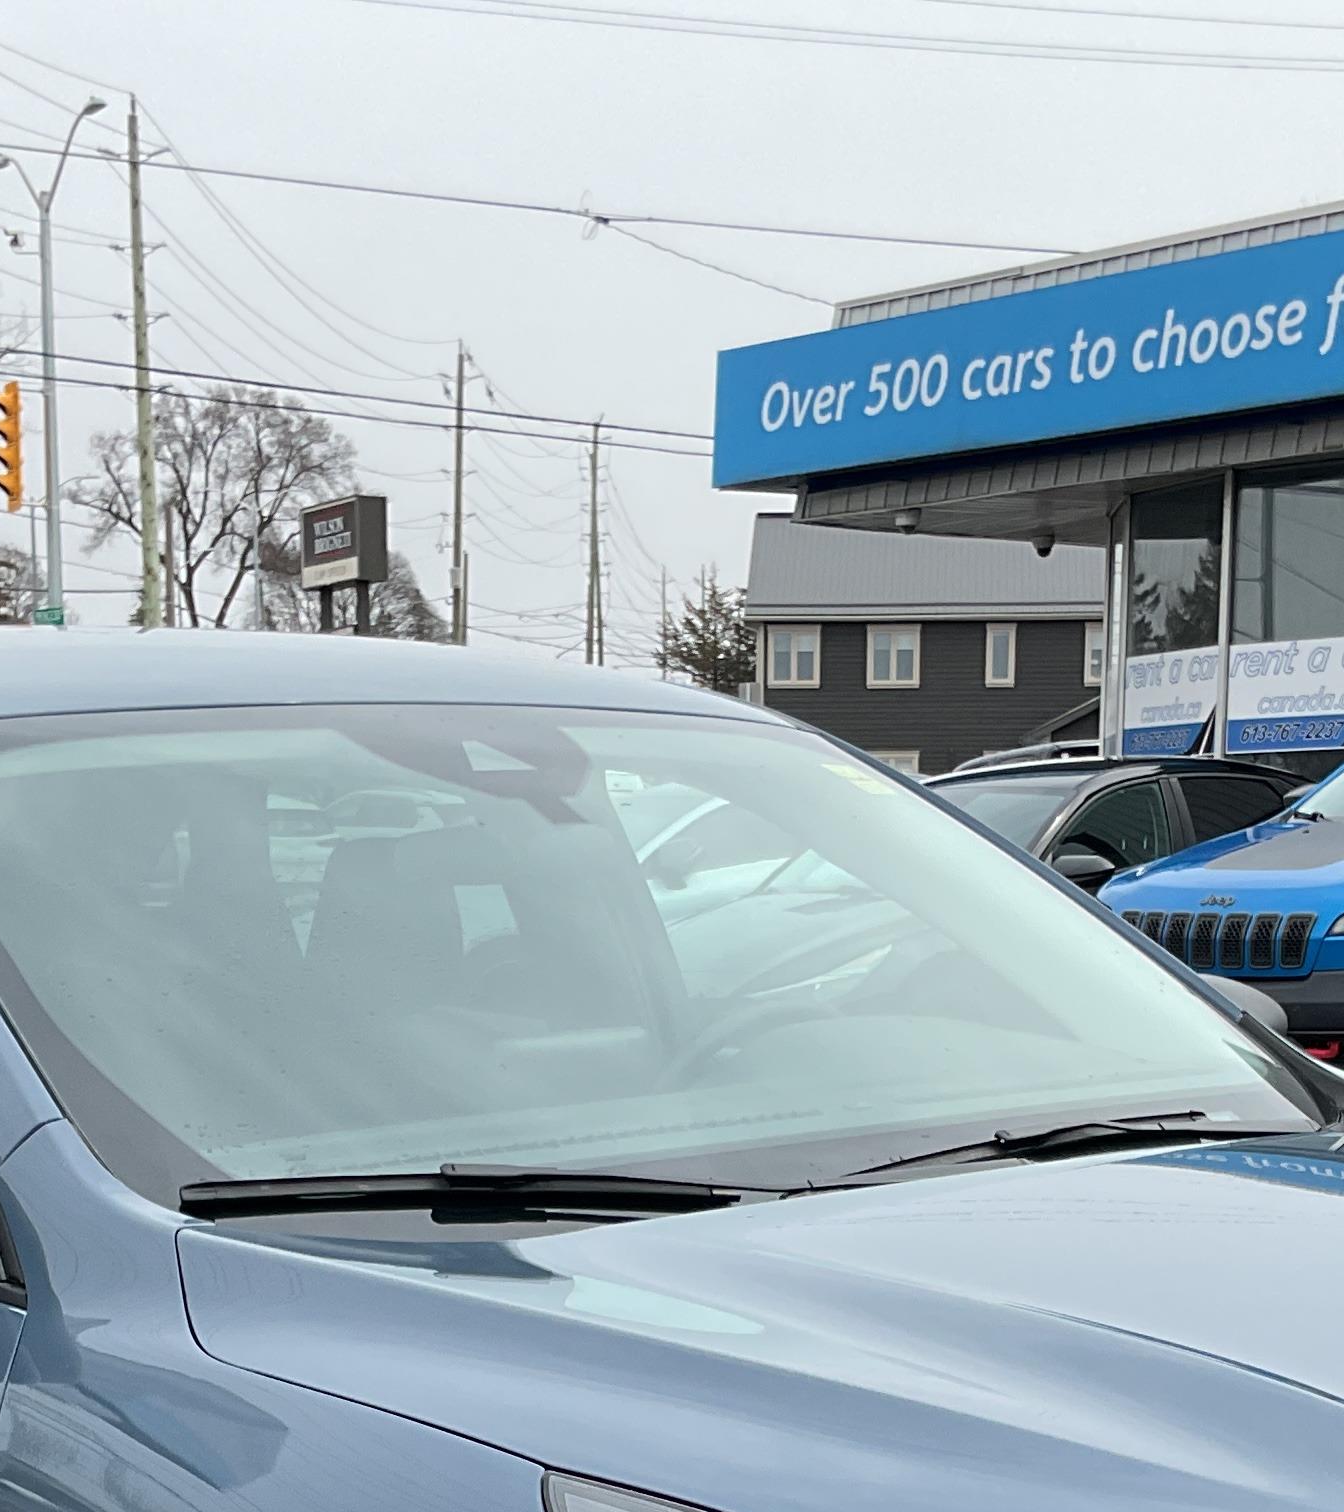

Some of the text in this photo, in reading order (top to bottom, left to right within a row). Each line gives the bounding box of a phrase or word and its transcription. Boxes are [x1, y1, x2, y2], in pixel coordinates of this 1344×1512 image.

[760, 381, 855, 432] Over
[863, 354, 948, 417] 500
[962, 345, 1054, 400] cars
[1069, 328, 1116, 384] to
[1132, 299, 1307, 373] choose
[1125, 655, 1165, 689] rent
[1168, 656, 1183, 685] a
[1230, 641, 1299, 679] rent
[1308, 646, 1331, 673] a
[1199, 894, 1236, 908] Jeep
